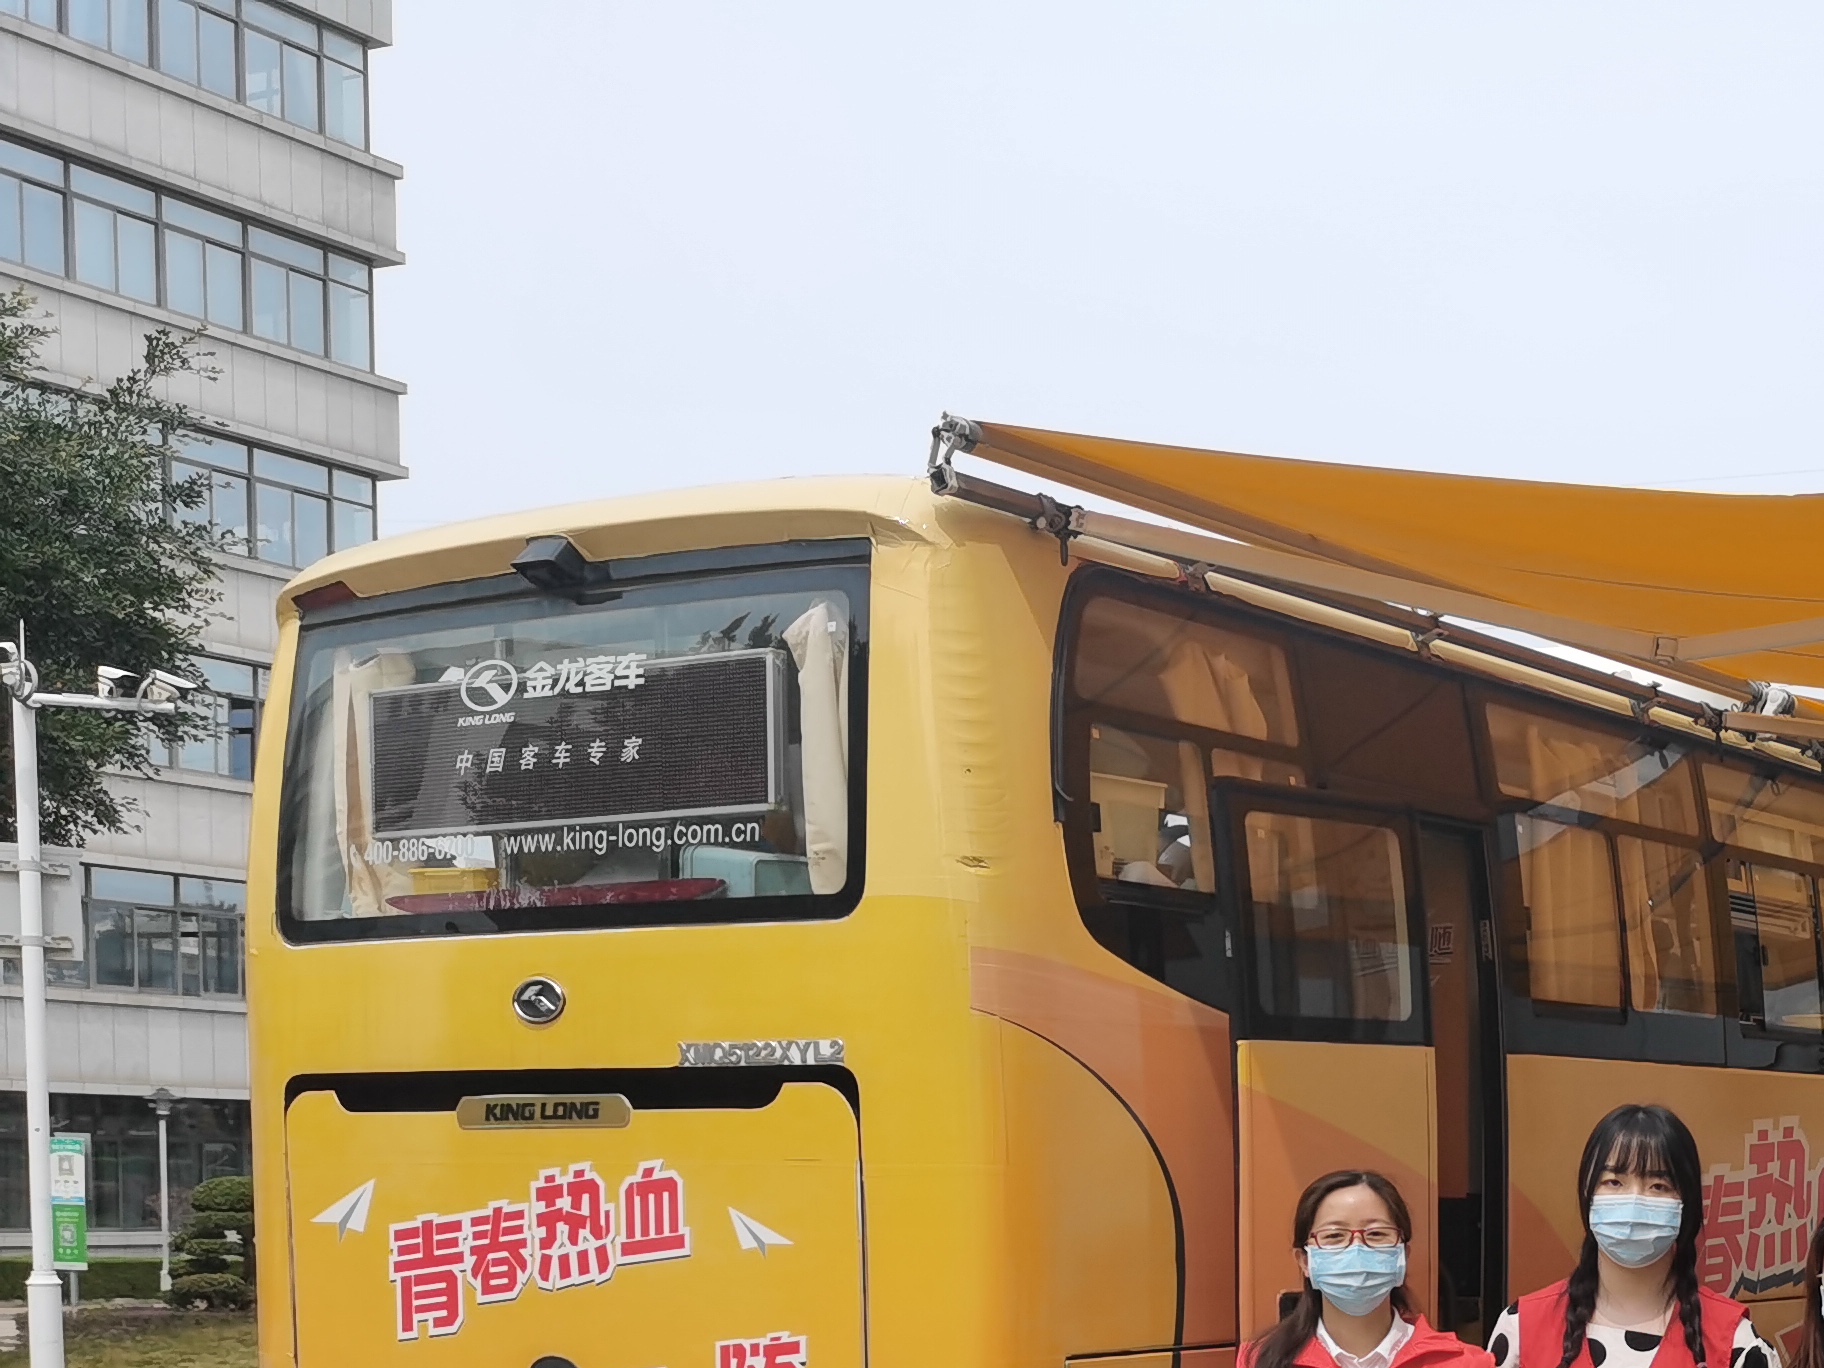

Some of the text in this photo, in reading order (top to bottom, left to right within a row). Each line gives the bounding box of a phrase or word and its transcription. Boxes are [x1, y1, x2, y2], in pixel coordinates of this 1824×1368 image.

[523, 652, 646, 698] 金龙客车
[457, 712, 516, 727] KING LONG
[455, 736, 643, 775] 中国客车专家
[504, 820, 760, 855] www.king-long.com.cn
[484, 1101, 600, 1122] KING LONG
[390, 1161, 690, 1338] 青春热血
